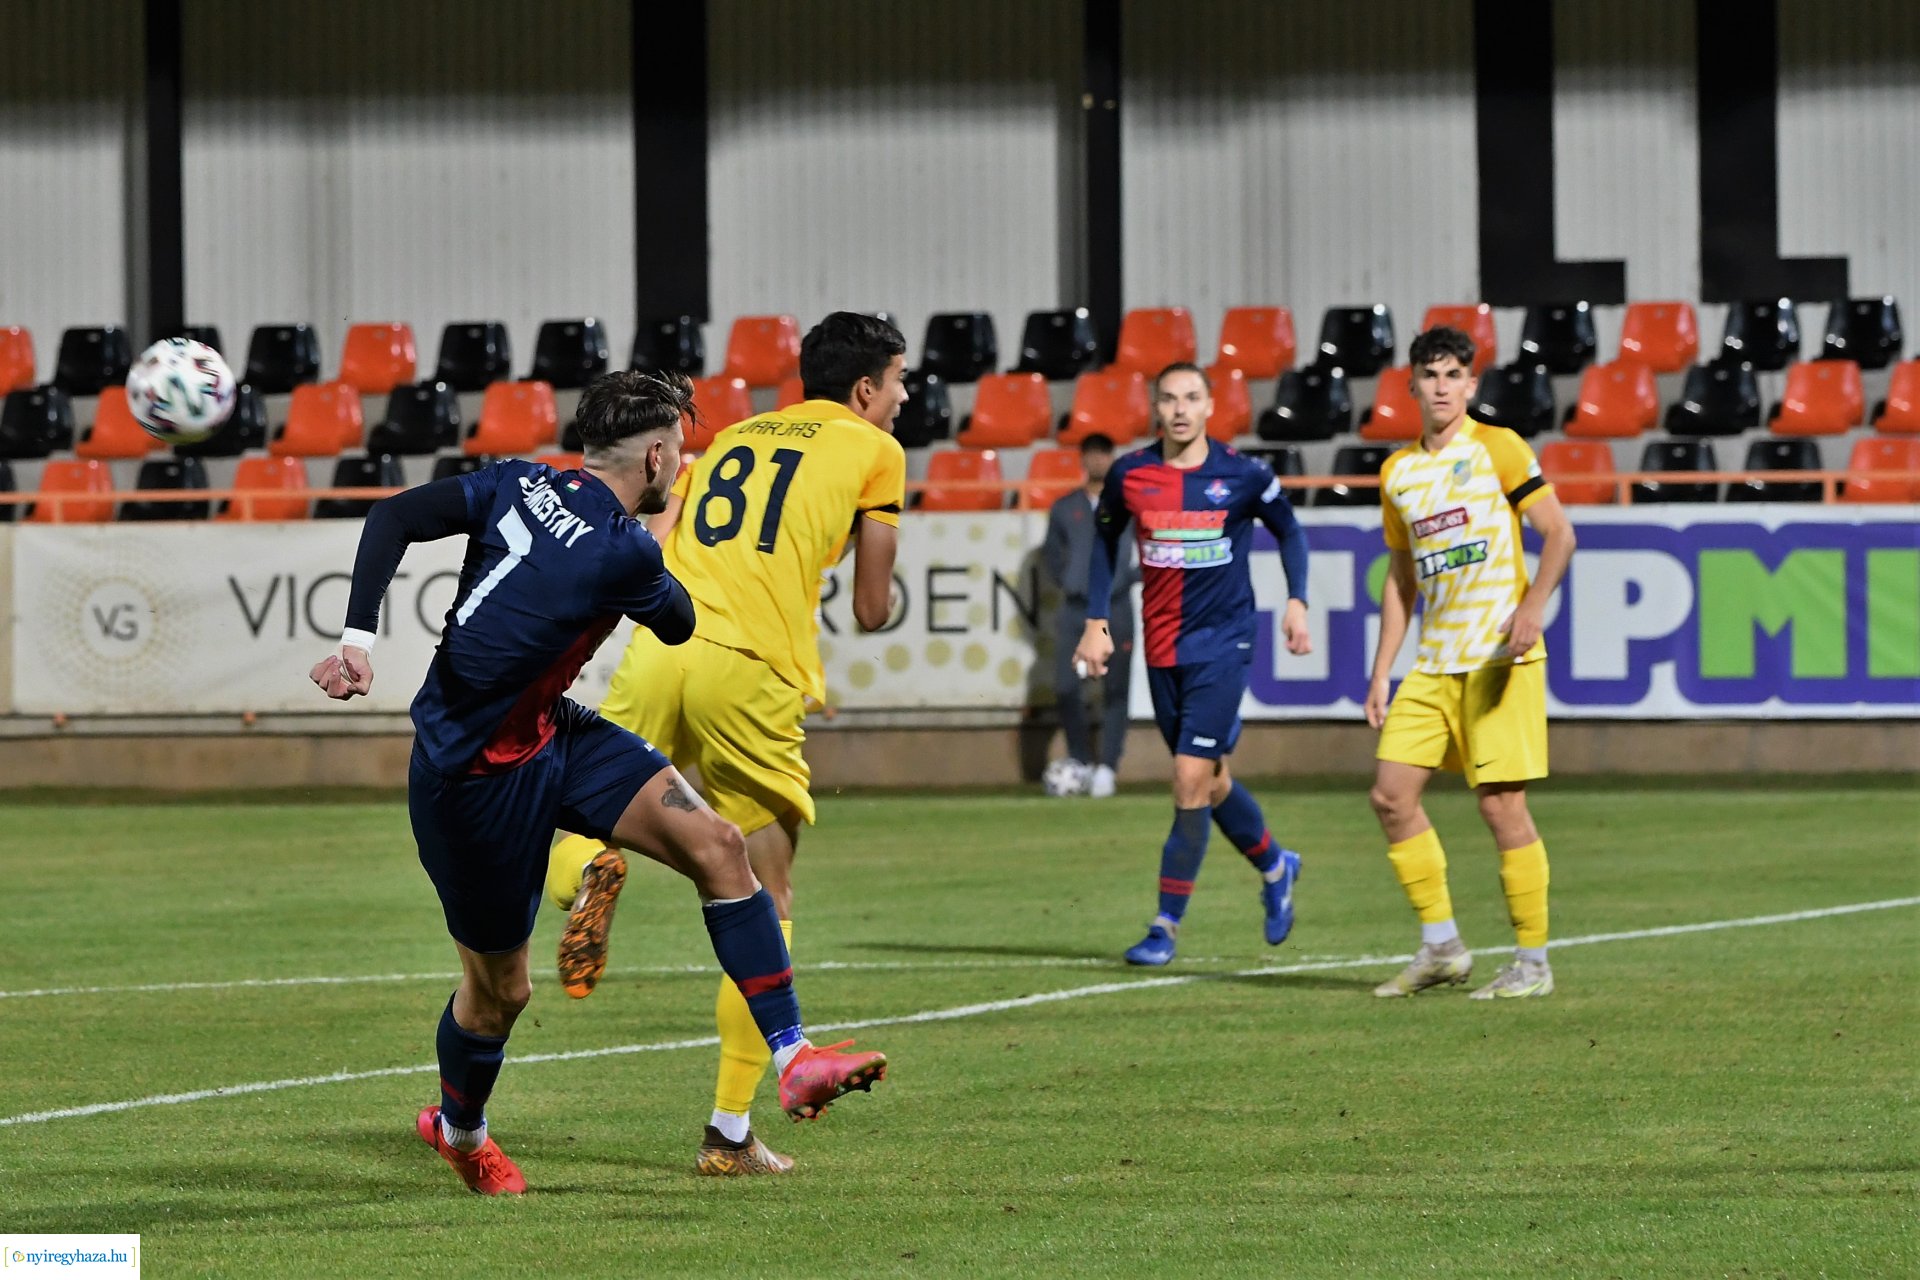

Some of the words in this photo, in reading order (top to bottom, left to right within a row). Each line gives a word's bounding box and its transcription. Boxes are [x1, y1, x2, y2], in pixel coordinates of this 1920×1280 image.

[695, 445, 804, 554] 81
[456, 504, 533, 627] 7
[92, 604, 139, 641] VG
